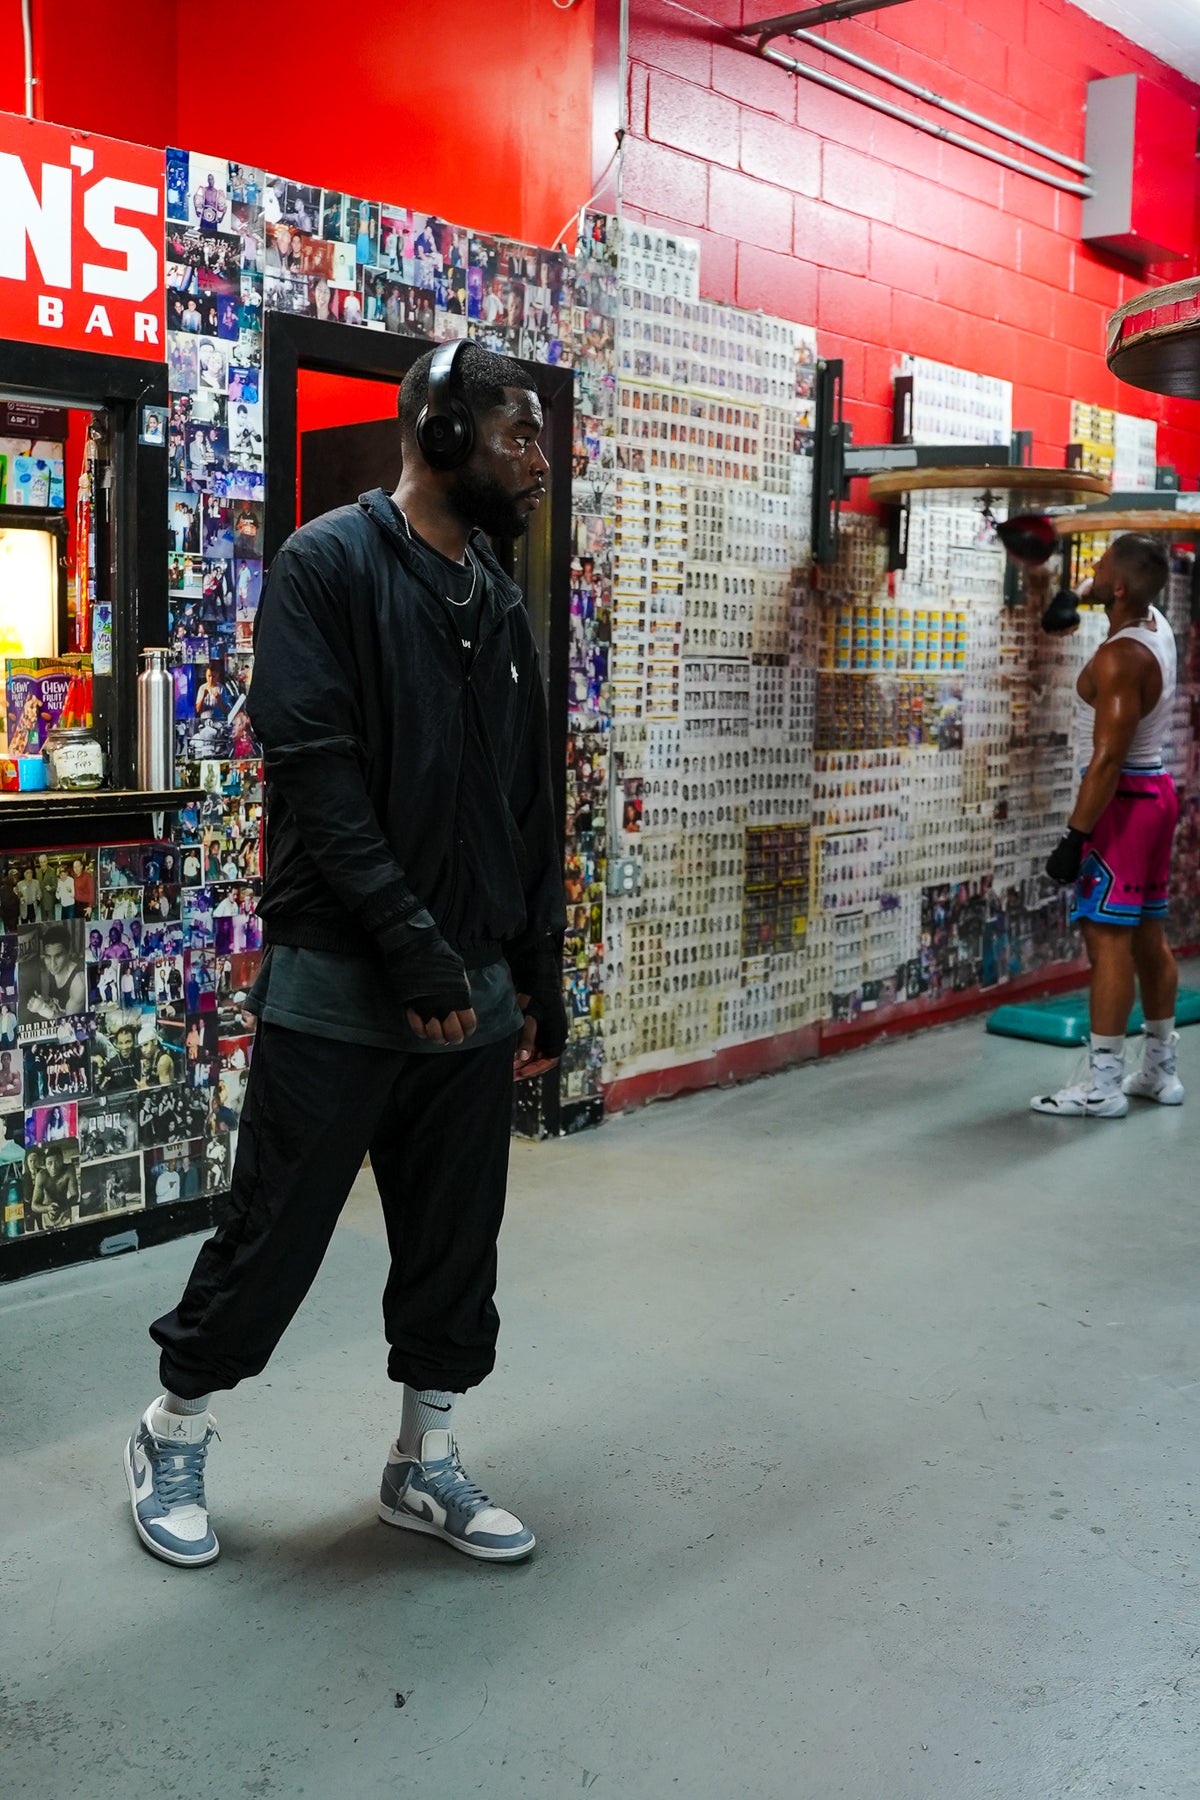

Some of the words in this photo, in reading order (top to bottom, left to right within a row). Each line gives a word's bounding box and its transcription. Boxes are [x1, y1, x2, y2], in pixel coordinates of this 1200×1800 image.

[38, 294, 159, 344] BAR
[42, 693, 62, 702] FRUIT
[47, 702, 63, 710] NUT
